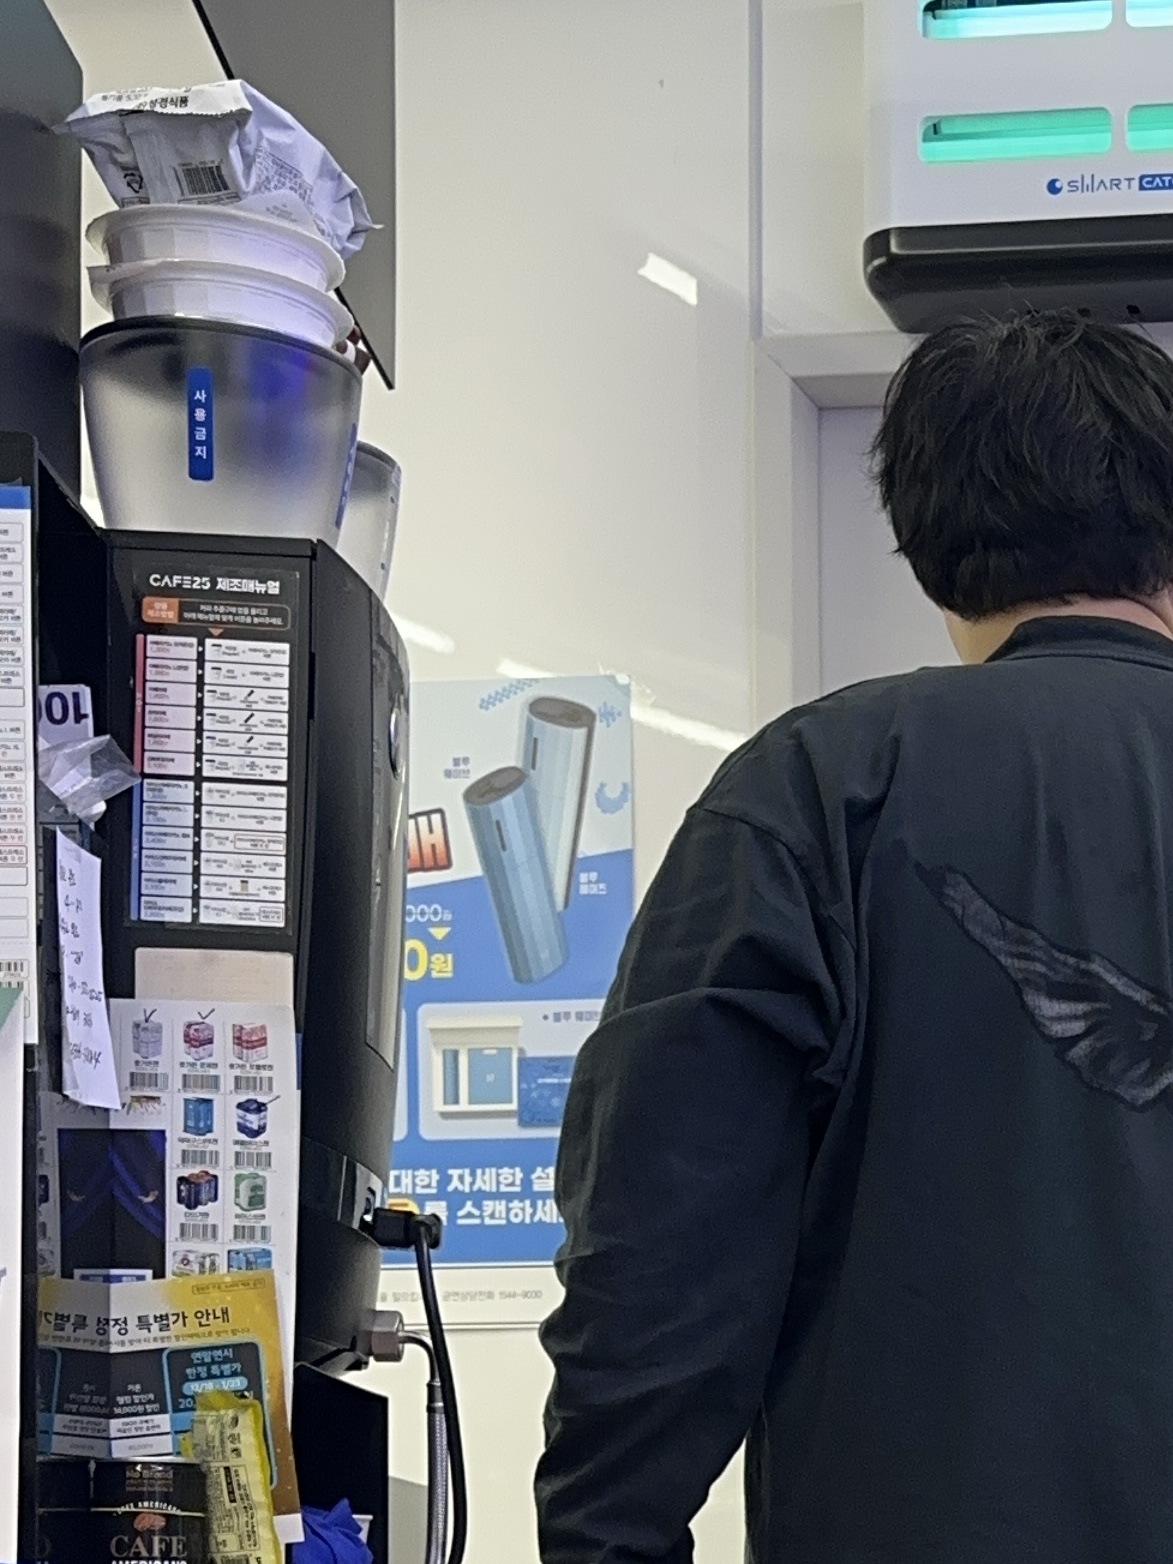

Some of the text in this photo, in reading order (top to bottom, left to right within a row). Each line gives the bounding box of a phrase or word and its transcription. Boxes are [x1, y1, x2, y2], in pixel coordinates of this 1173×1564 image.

[1067, 174, 1135, 193] SMART
[194, 389, 207, 459] 사용금지
[149, 574, 211, 589] CAFE25
[390, 1168, 440, 1195] 대한
[447, 1167, 523, 1193] 자세한
[457, 1200, 566, 1225] 스캔하세
[135, 1309, 188, 1333] 특별가
[194, 1306, 230, 1328] 안내
[190, 1348, 234, 1364] 연말연시
[211, 1362, 242, 1376] 특별가
[110, 1535, 188, 1558] CAFE
